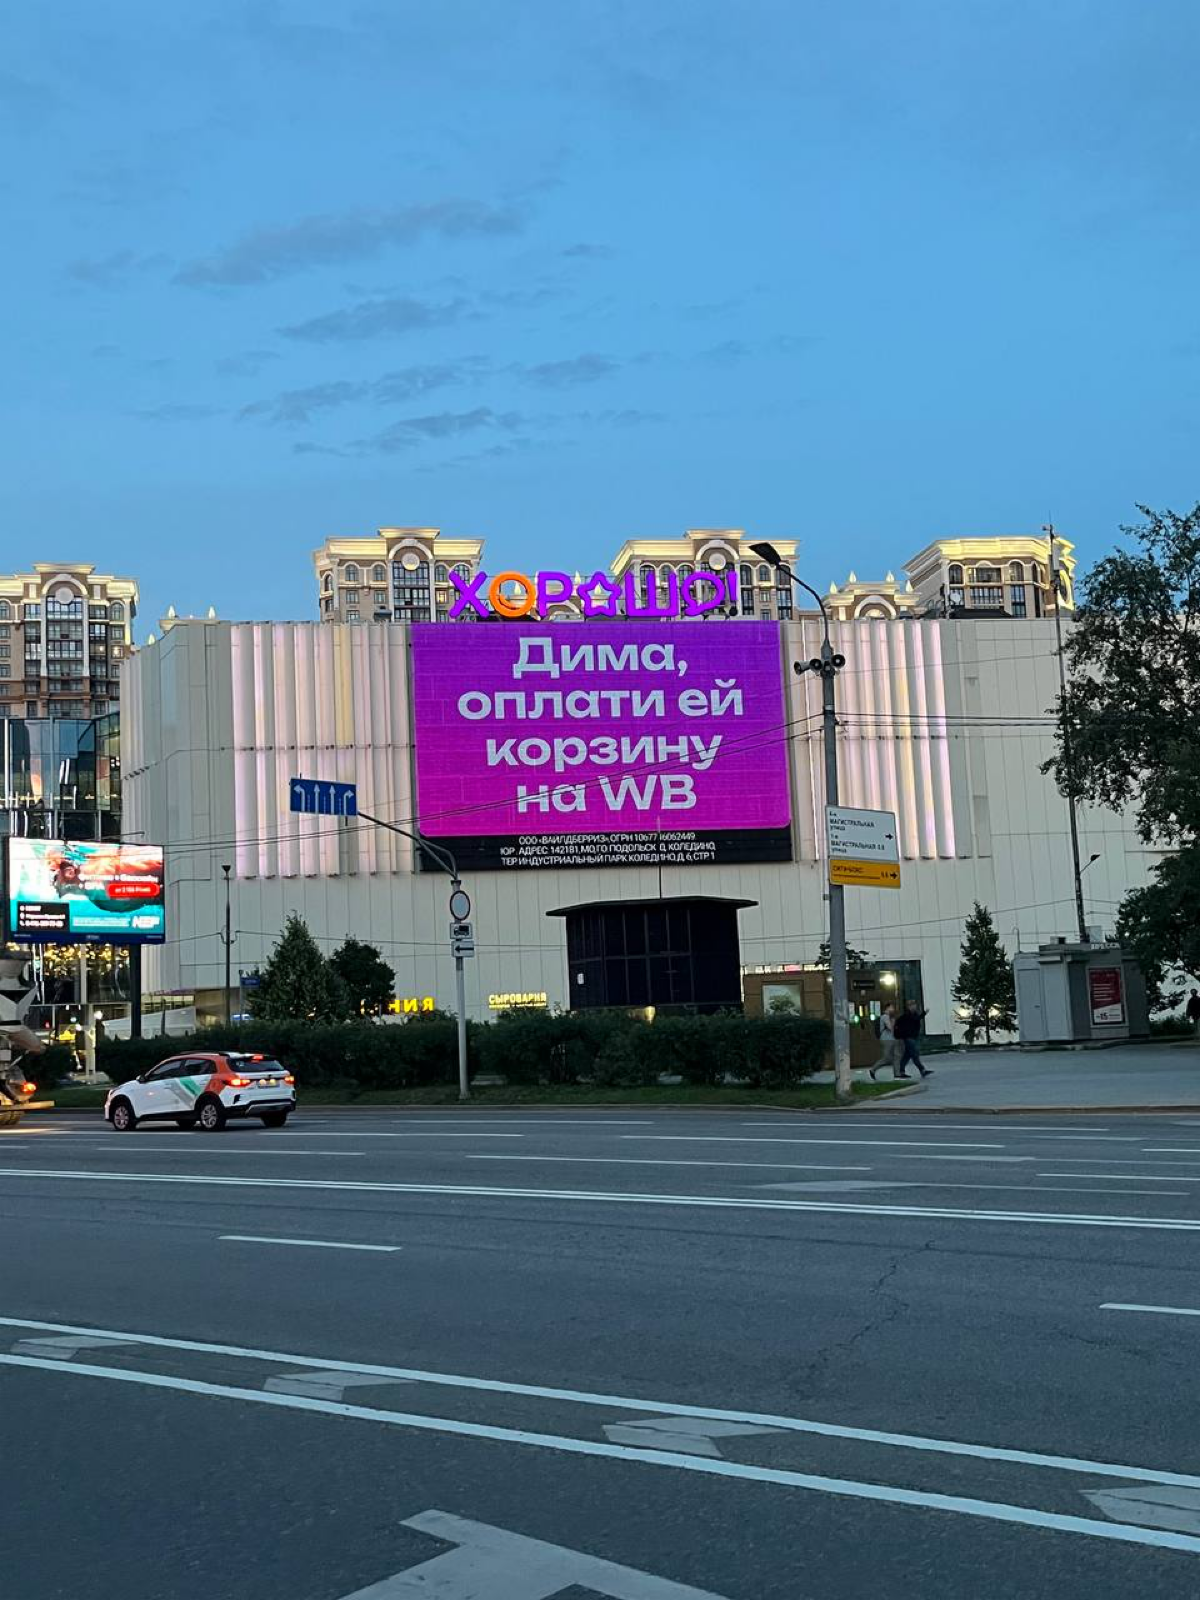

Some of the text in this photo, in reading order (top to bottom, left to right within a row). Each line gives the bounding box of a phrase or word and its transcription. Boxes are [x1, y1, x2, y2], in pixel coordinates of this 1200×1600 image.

[512, 636, 687, 679] Дима,
[458, 679, 744, 720] оплати ей
[485, 734, 723, 772] корзину
[516, 773, 697, 813] на WB
[518, 836, 538, 845] ООО
[519, 853, 604, 866] ИНДУСТРИАЛЬНЫЙ
[605, 854, 628, 863] ПАРК
